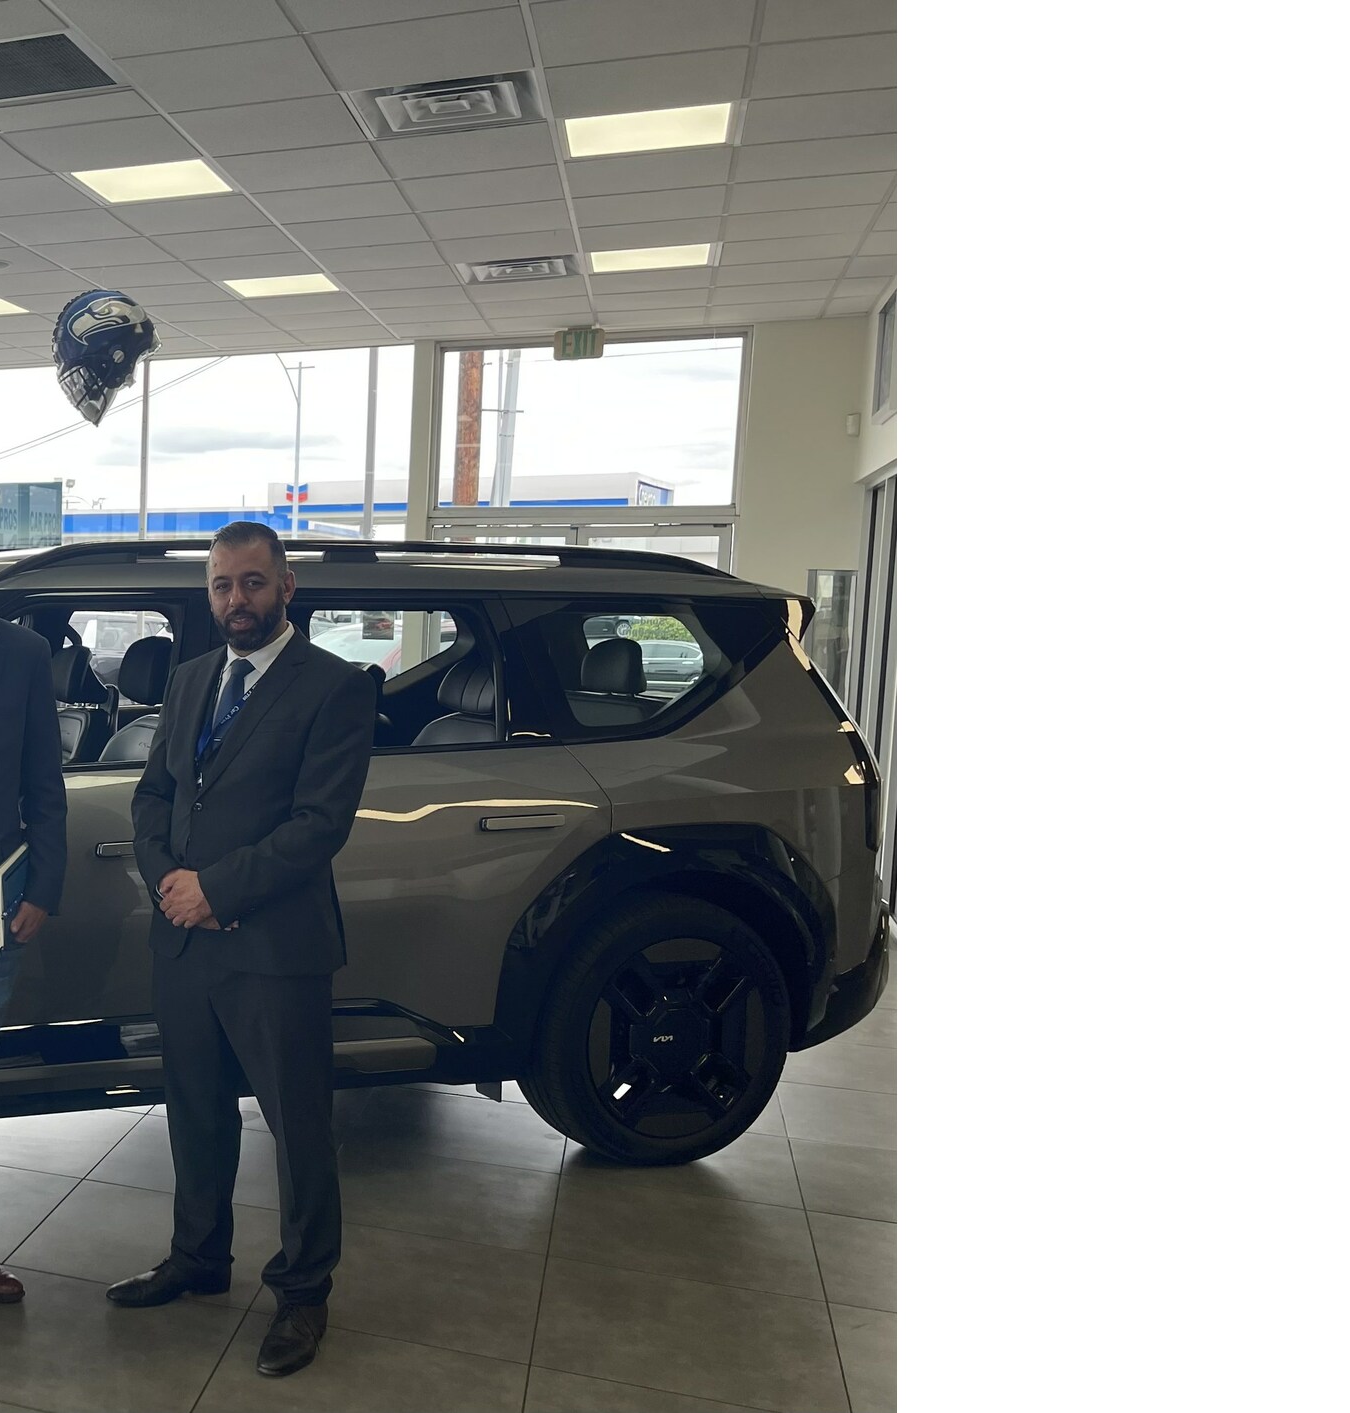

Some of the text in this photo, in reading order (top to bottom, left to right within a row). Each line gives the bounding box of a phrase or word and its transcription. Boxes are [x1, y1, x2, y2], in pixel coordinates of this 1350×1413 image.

[562, 331, 599, 357] EXIT
[0, 508, 18, 531] PROS
[30, 511, 43, 532] CAR
